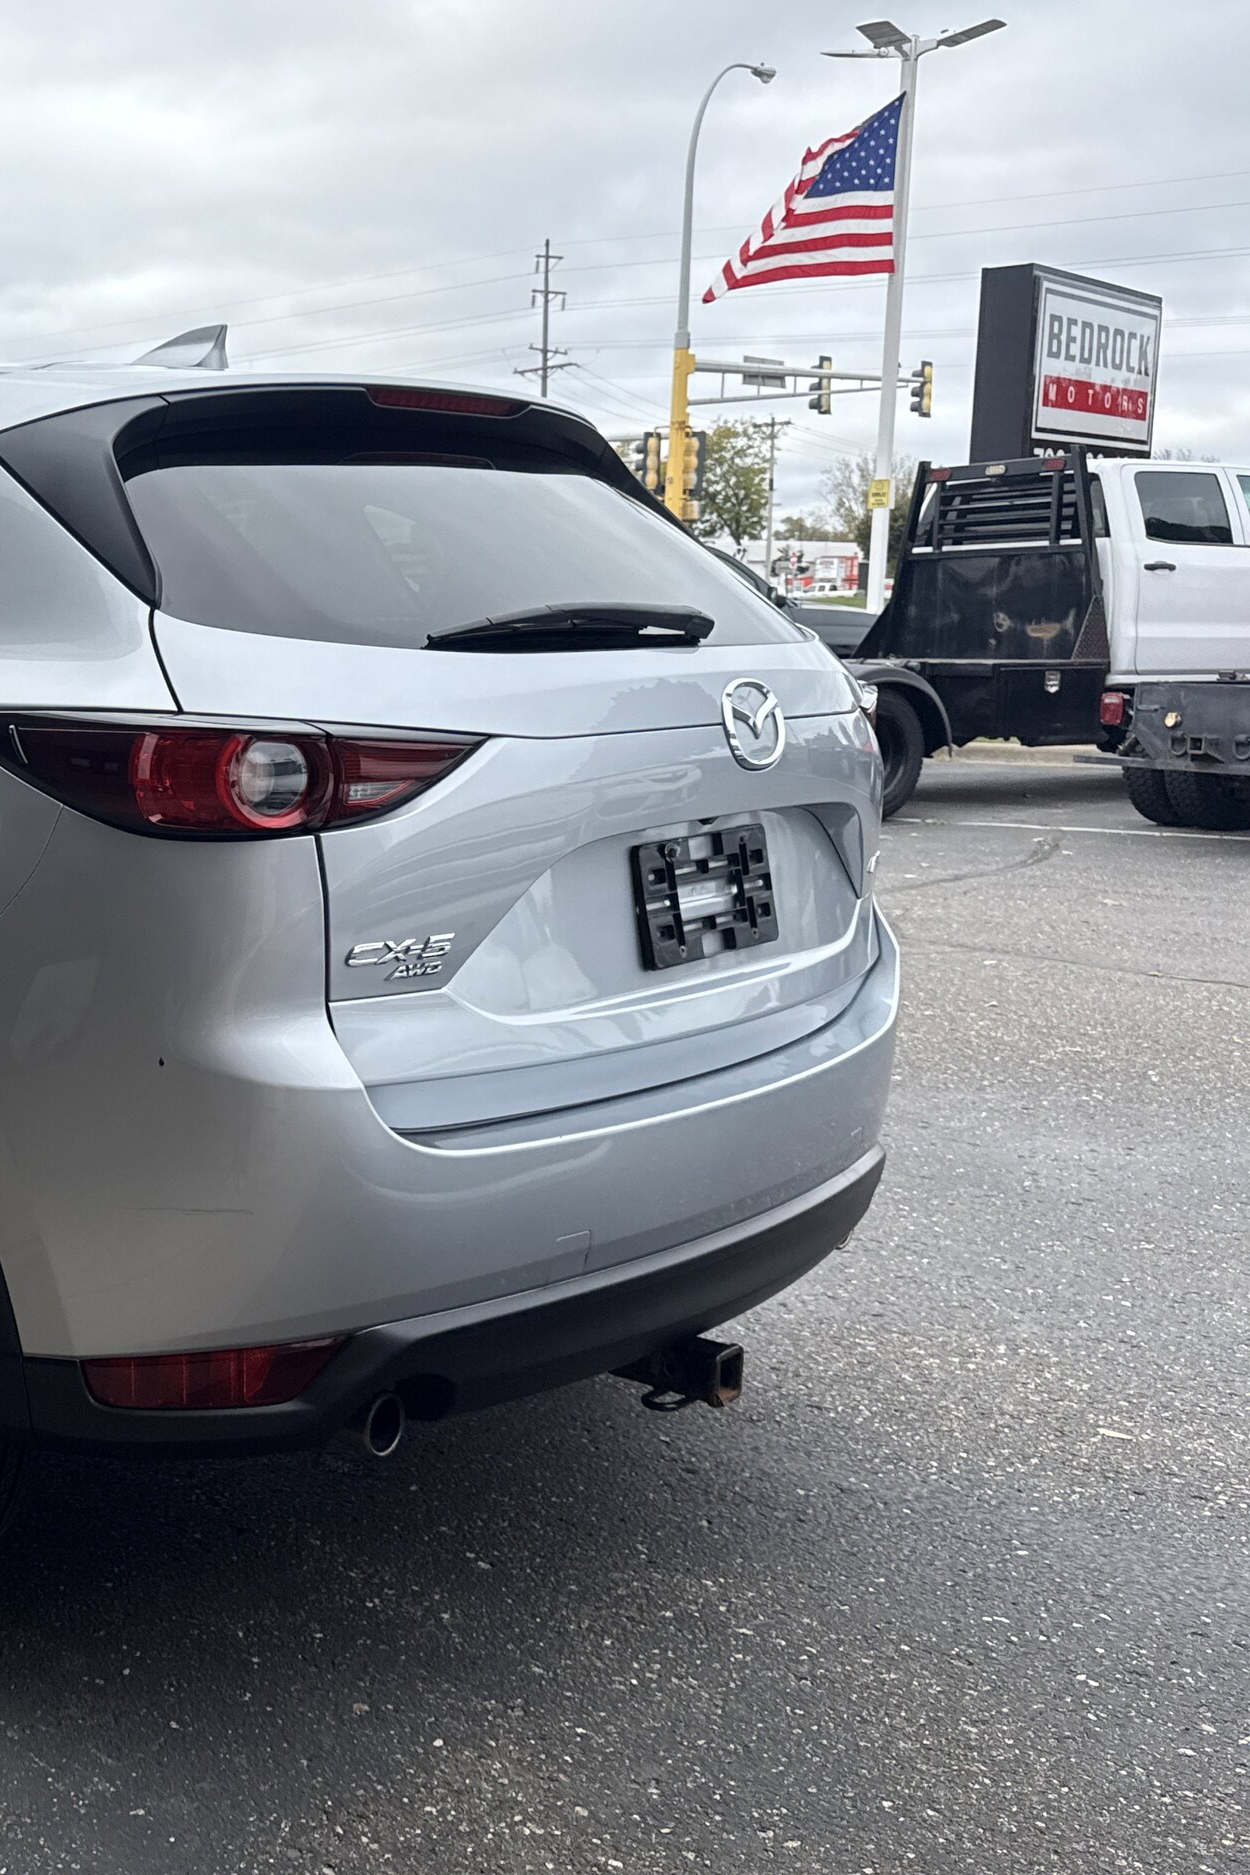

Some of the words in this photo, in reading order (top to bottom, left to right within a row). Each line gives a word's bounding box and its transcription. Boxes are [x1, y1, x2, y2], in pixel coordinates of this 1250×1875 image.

[1046, 313, 1151, 377] BEDROCK
[1048, 383, 1145, 414] MOTORS
[344, 932, 456, 967] CX-5
[385, 960, 443, 981] AWD
